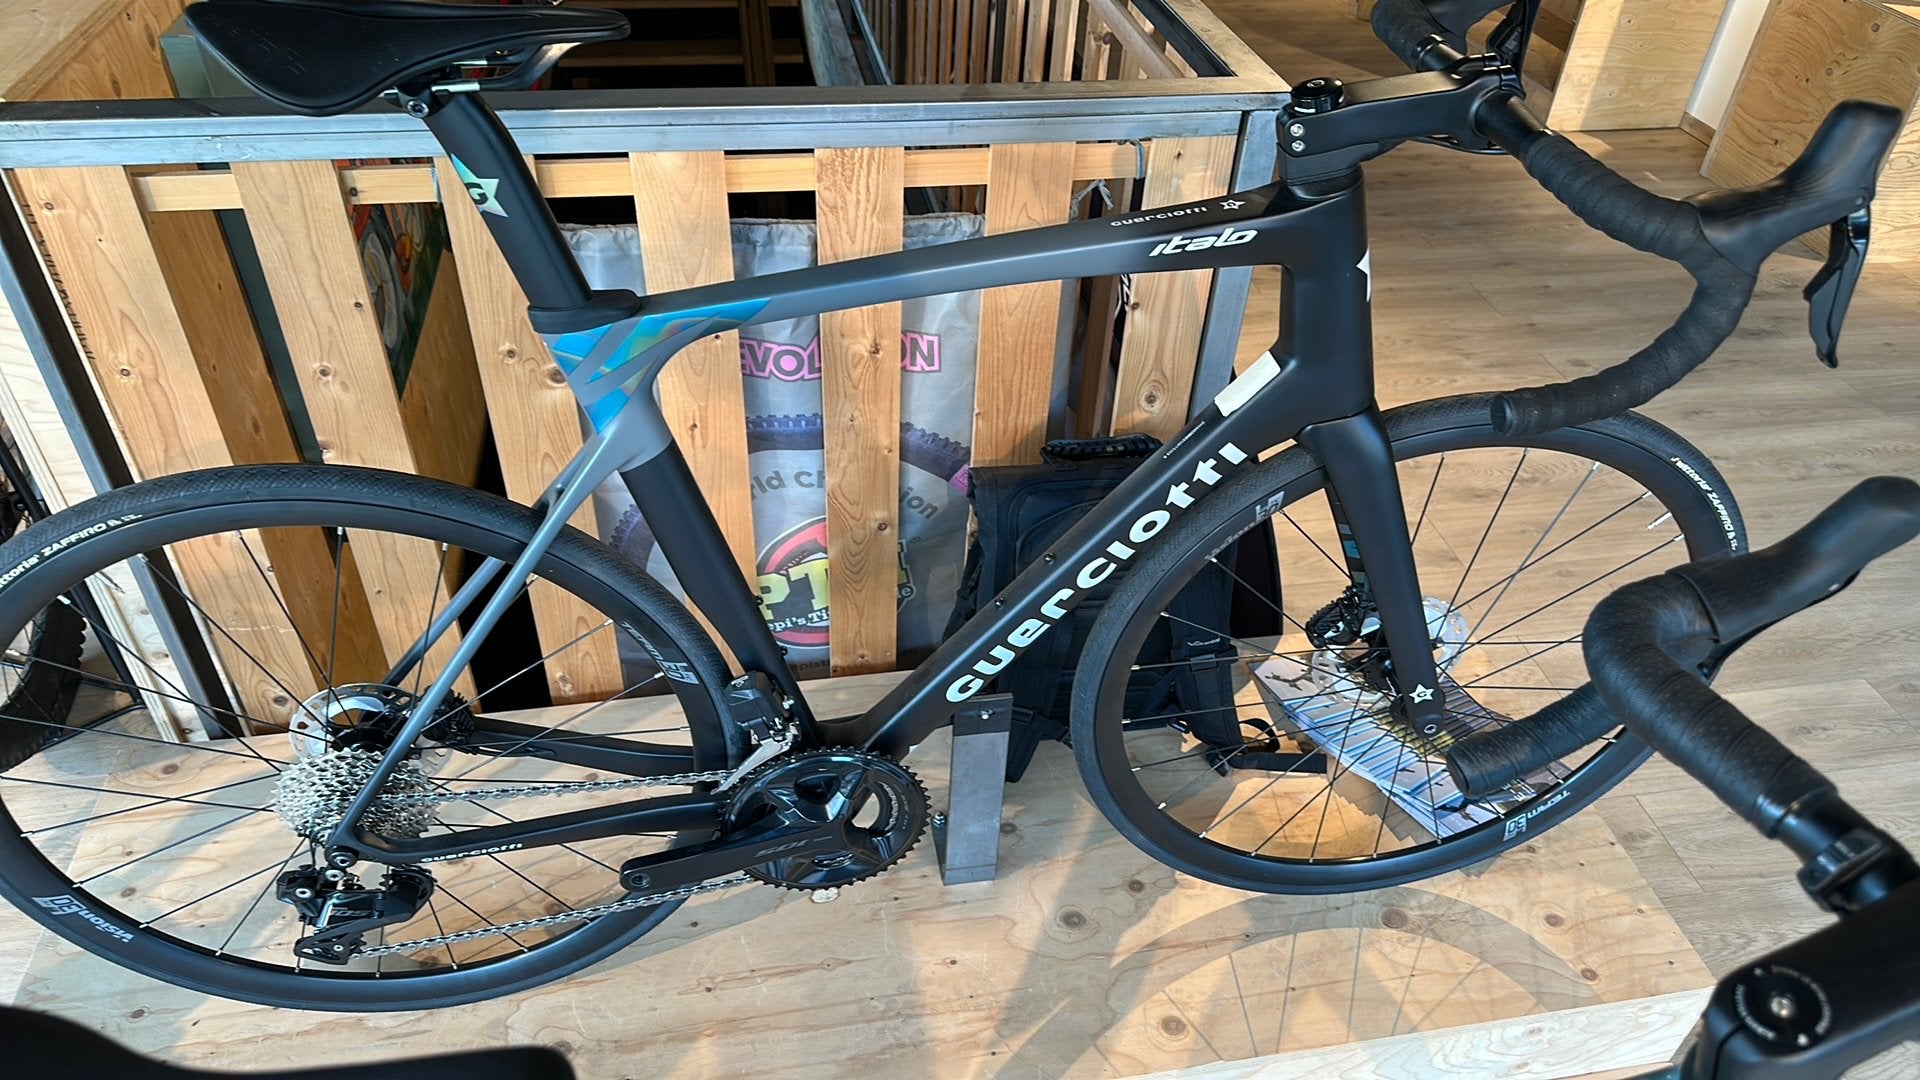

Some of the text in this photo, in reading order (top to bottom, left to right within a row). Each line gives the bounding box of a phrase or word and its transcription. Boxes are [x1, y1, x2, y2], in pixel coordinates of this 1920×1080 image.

[1149, 228, 1258, 256] italo
[1707, 492, 1735, 531] ZAFFIRO
[41, 523, 107, 557] ZAFFIRO
